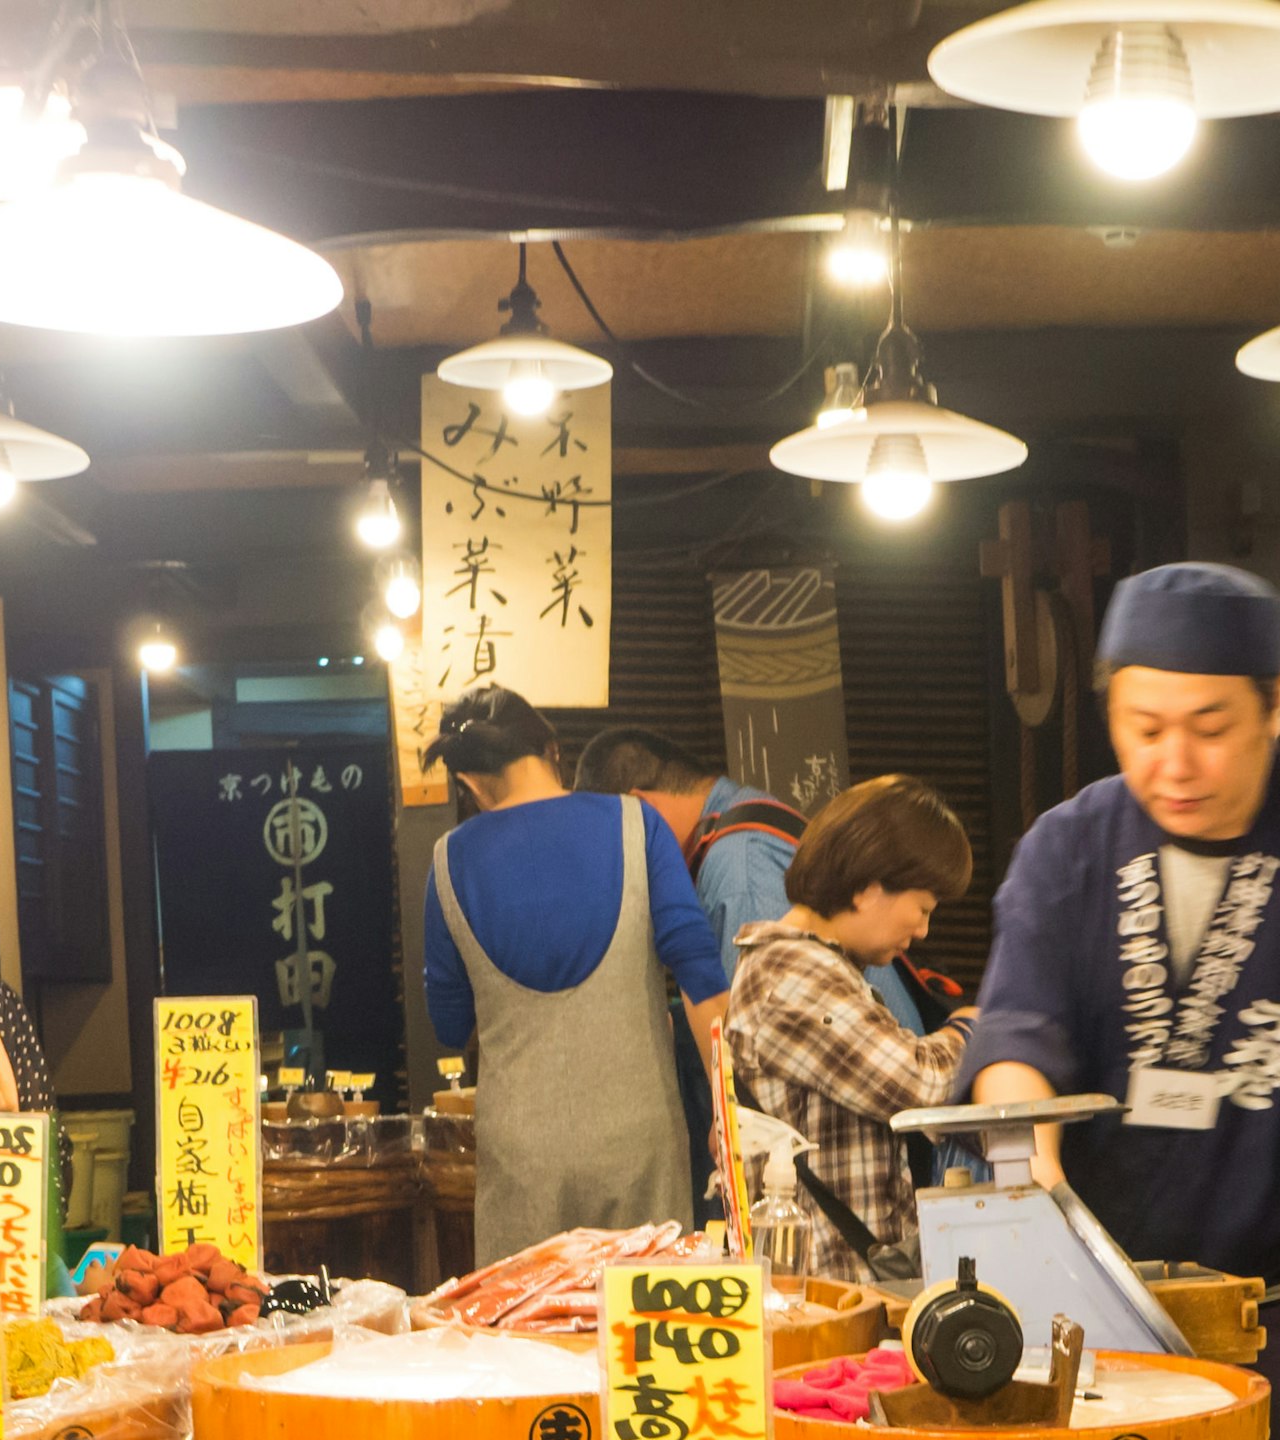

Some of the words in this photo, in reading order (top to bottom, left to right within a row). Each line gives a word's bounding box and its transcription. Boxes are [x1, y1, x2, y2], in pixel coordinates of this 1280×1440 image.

[219, 764, 363, 801] 京つけもの
[271, 876, 337, 1008] 打田
